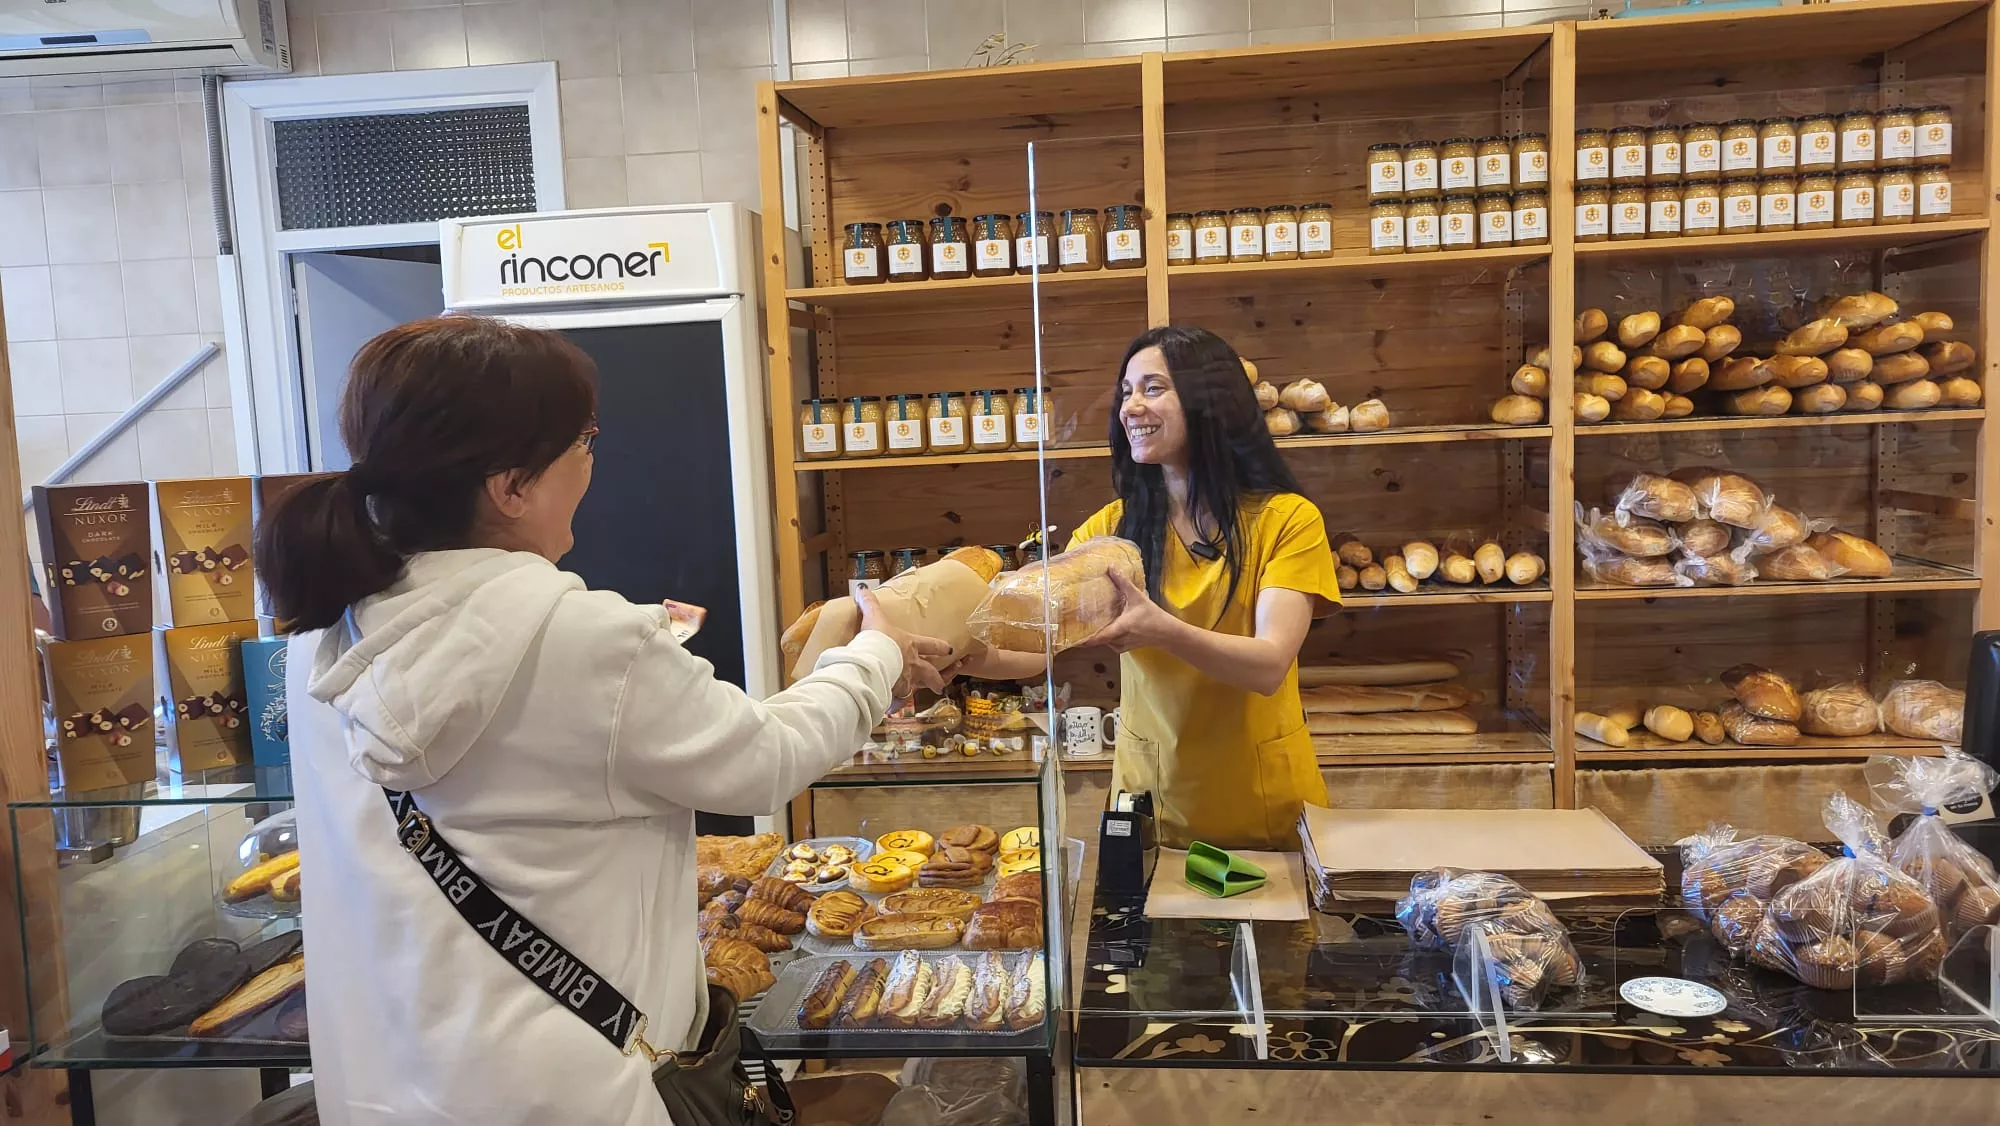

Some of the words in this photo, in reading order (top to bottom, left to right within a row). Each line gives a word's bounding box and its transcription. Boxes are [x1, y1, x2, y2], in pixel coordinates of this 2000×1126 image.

[496, 224, 522, 250] el
[500, 251, 662, 284] rinconer
[502, 285, 563, 296] PRODUCTOS
[566, 282, 625, 293] ARTESANOS
[71, 496, 118, 512] Lindt
[74, 513, 128, 525] NUXOR
[188, 634, 229, 650] Lindt
[477, 910, 599, 1010] BIMBAY
